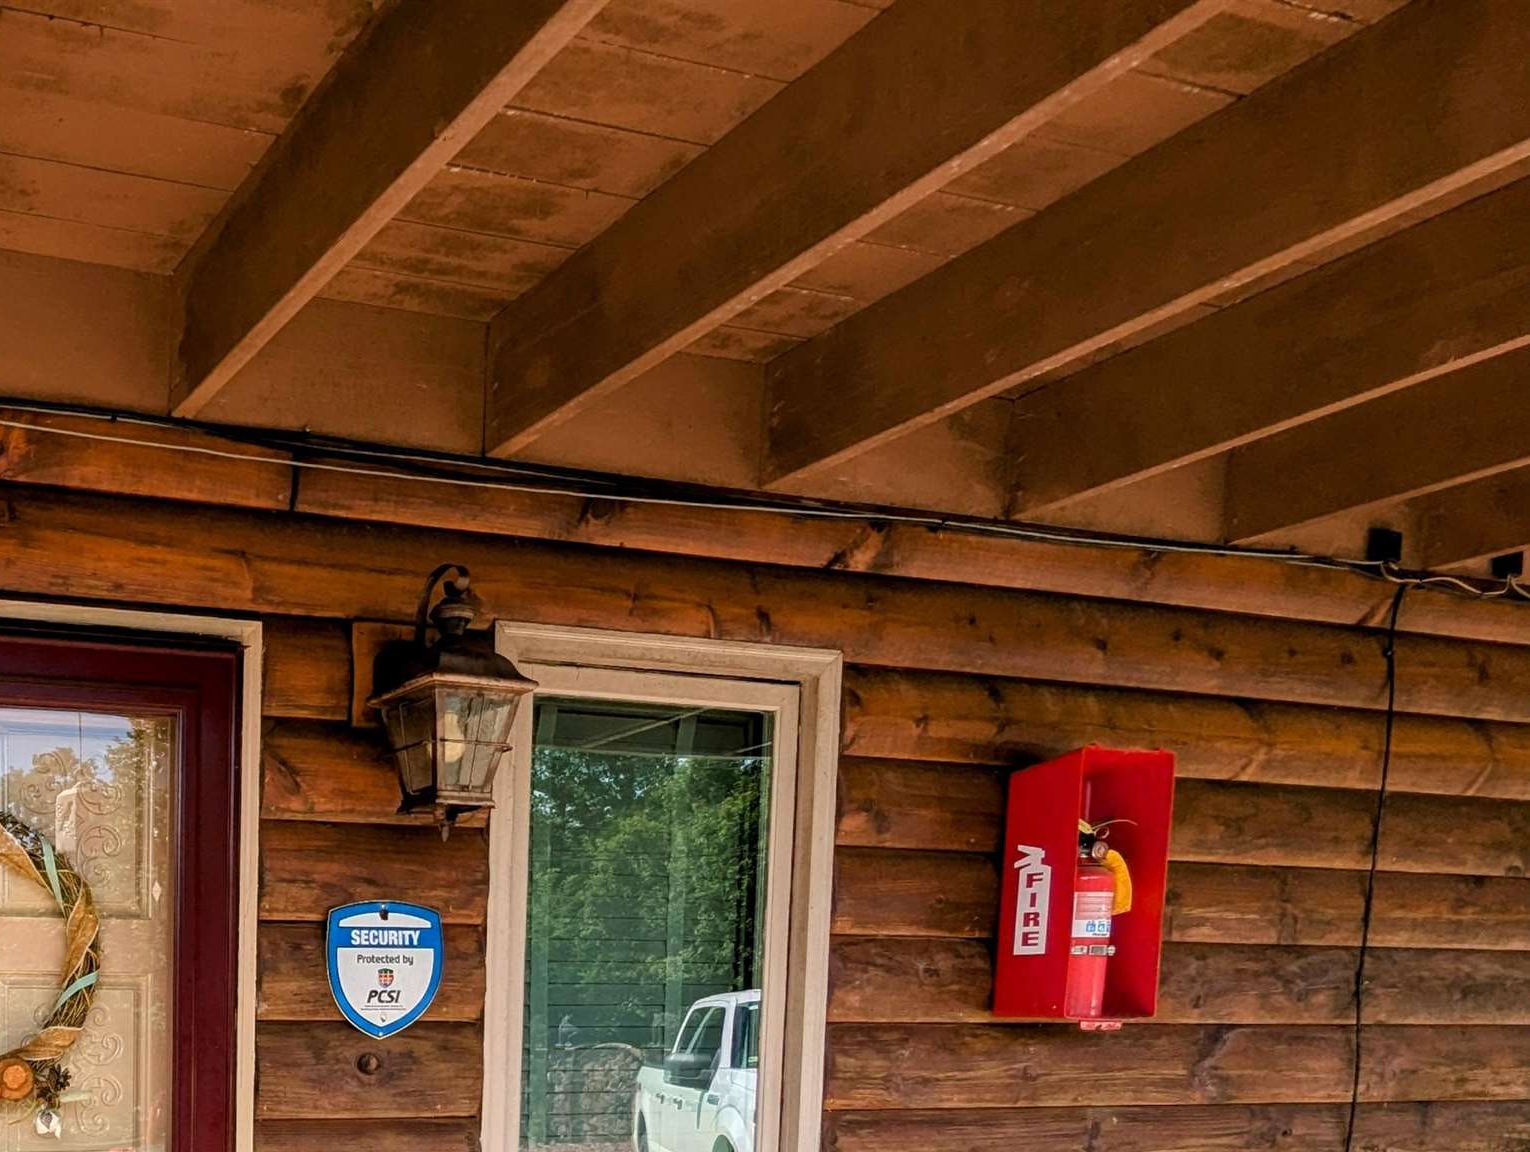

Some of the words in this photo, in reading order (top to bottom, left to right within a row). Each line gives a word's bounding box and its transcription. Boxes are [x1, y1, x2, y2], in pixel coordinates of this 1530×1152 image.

[1020, 871, 1045, 947] FIRE
[350, 929, 421, 946] SECURITY
[356, 954, 401, 965] Protected
[402, 954, 414, 966] by
[367, 989, 402, 1004] PCSI
